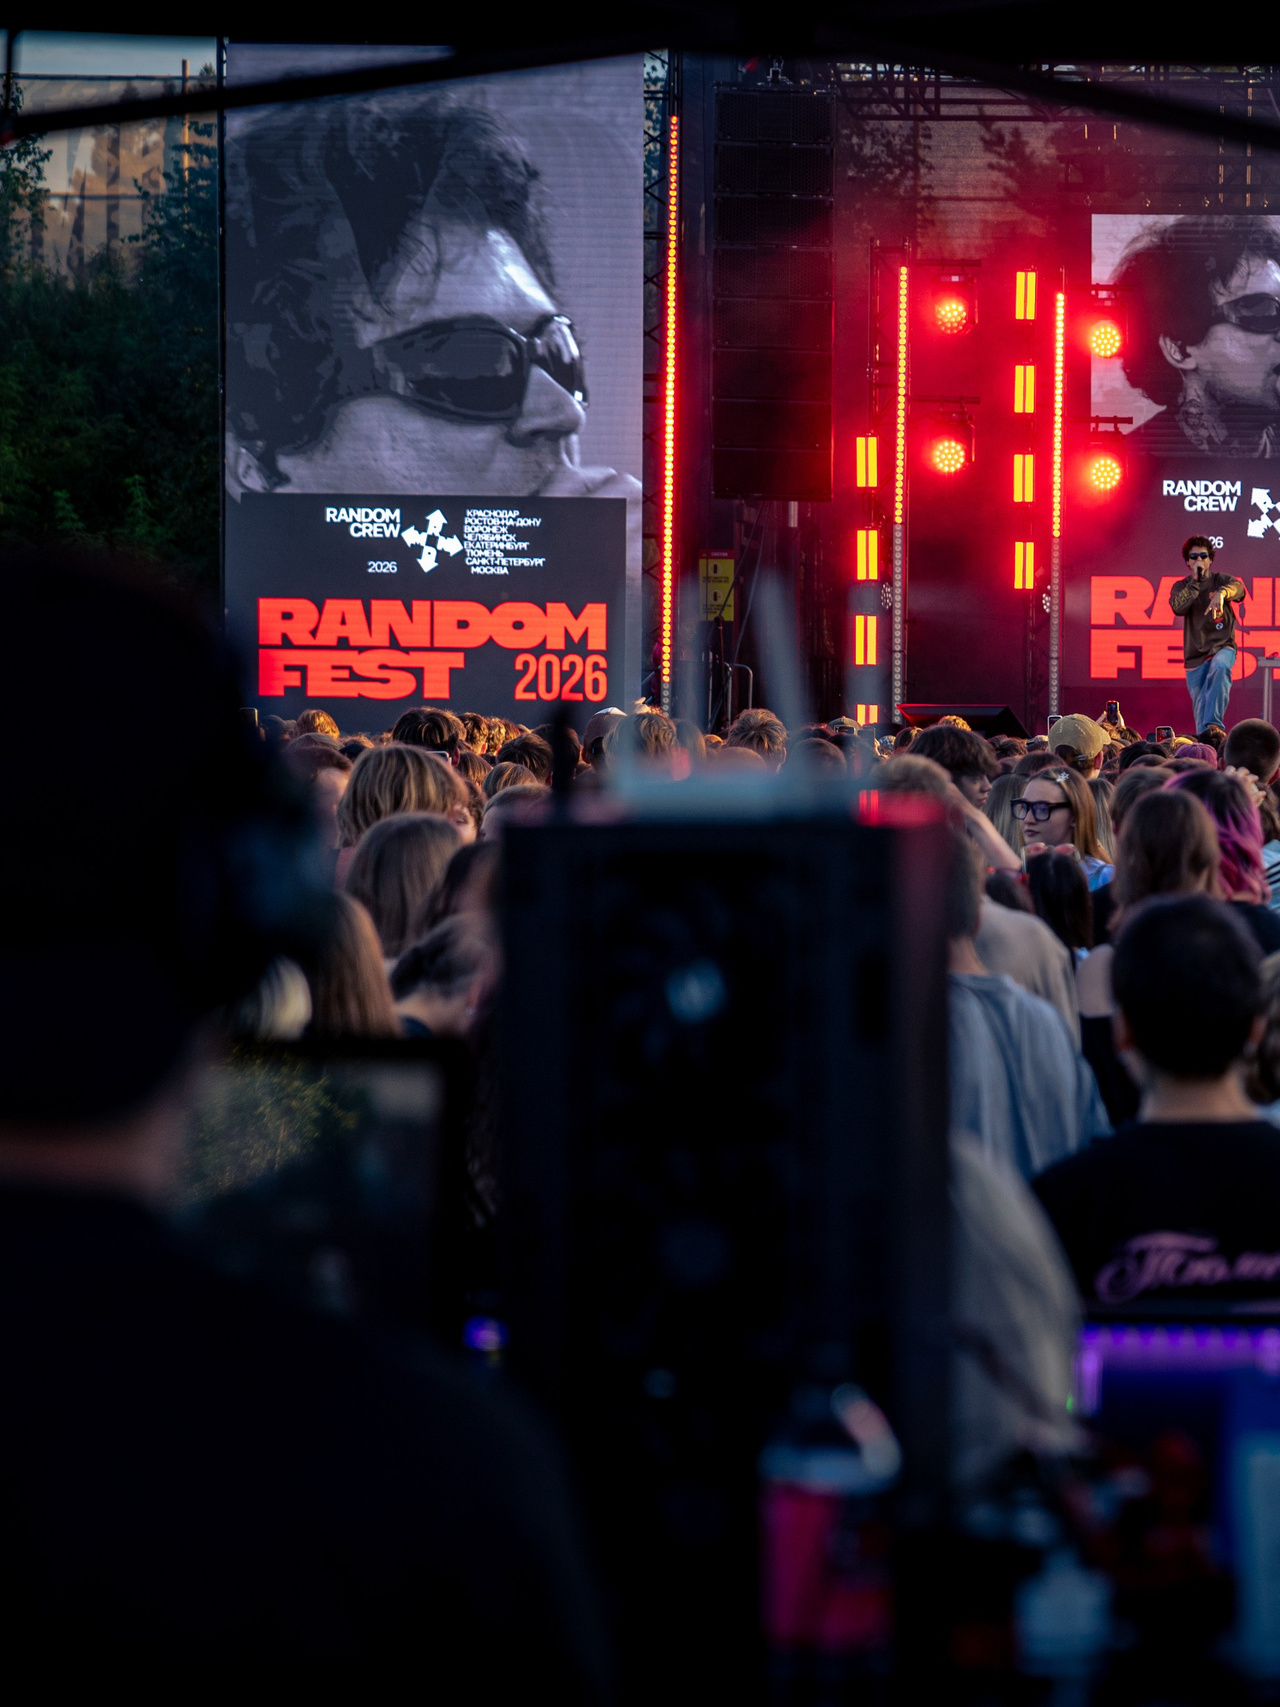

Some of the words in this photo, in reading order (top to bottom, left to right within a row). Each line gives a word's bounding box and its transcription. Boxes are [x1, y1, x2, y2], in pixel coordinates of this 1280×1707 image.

[1163, 480, 1241, 496] RANDOM
[1184, 496, 1238, 511] CREW
[325, 507, 401, 523] RANDOM
[466, 509, 520, 518] КРАСНОДАР
[464, 517, 542, 527] РОСТОВ-НА-ДОНУ
[349, 522, 401, 538] CREW
[464, 525, 509, 533] ВОРОНЕЖ
[463, 533, 516, 542] ЧЕЛЯБИНСК
[464, 541, 530, 550] ЕКАТЕРИНБУРГ
[466, 549, 504, 557] ТЮМЕНЬ
[465, 557, 546, 566] САНКТ-ПЕТЕРБУРГ
[367, 561, 398, 573] 2026
[471, 566, 509, 575] МОСКВА
[258, 597, 607, 651] RANDOM
[258, 648, 465, 700] FEST
[514, 653, 607, 702] 2026
